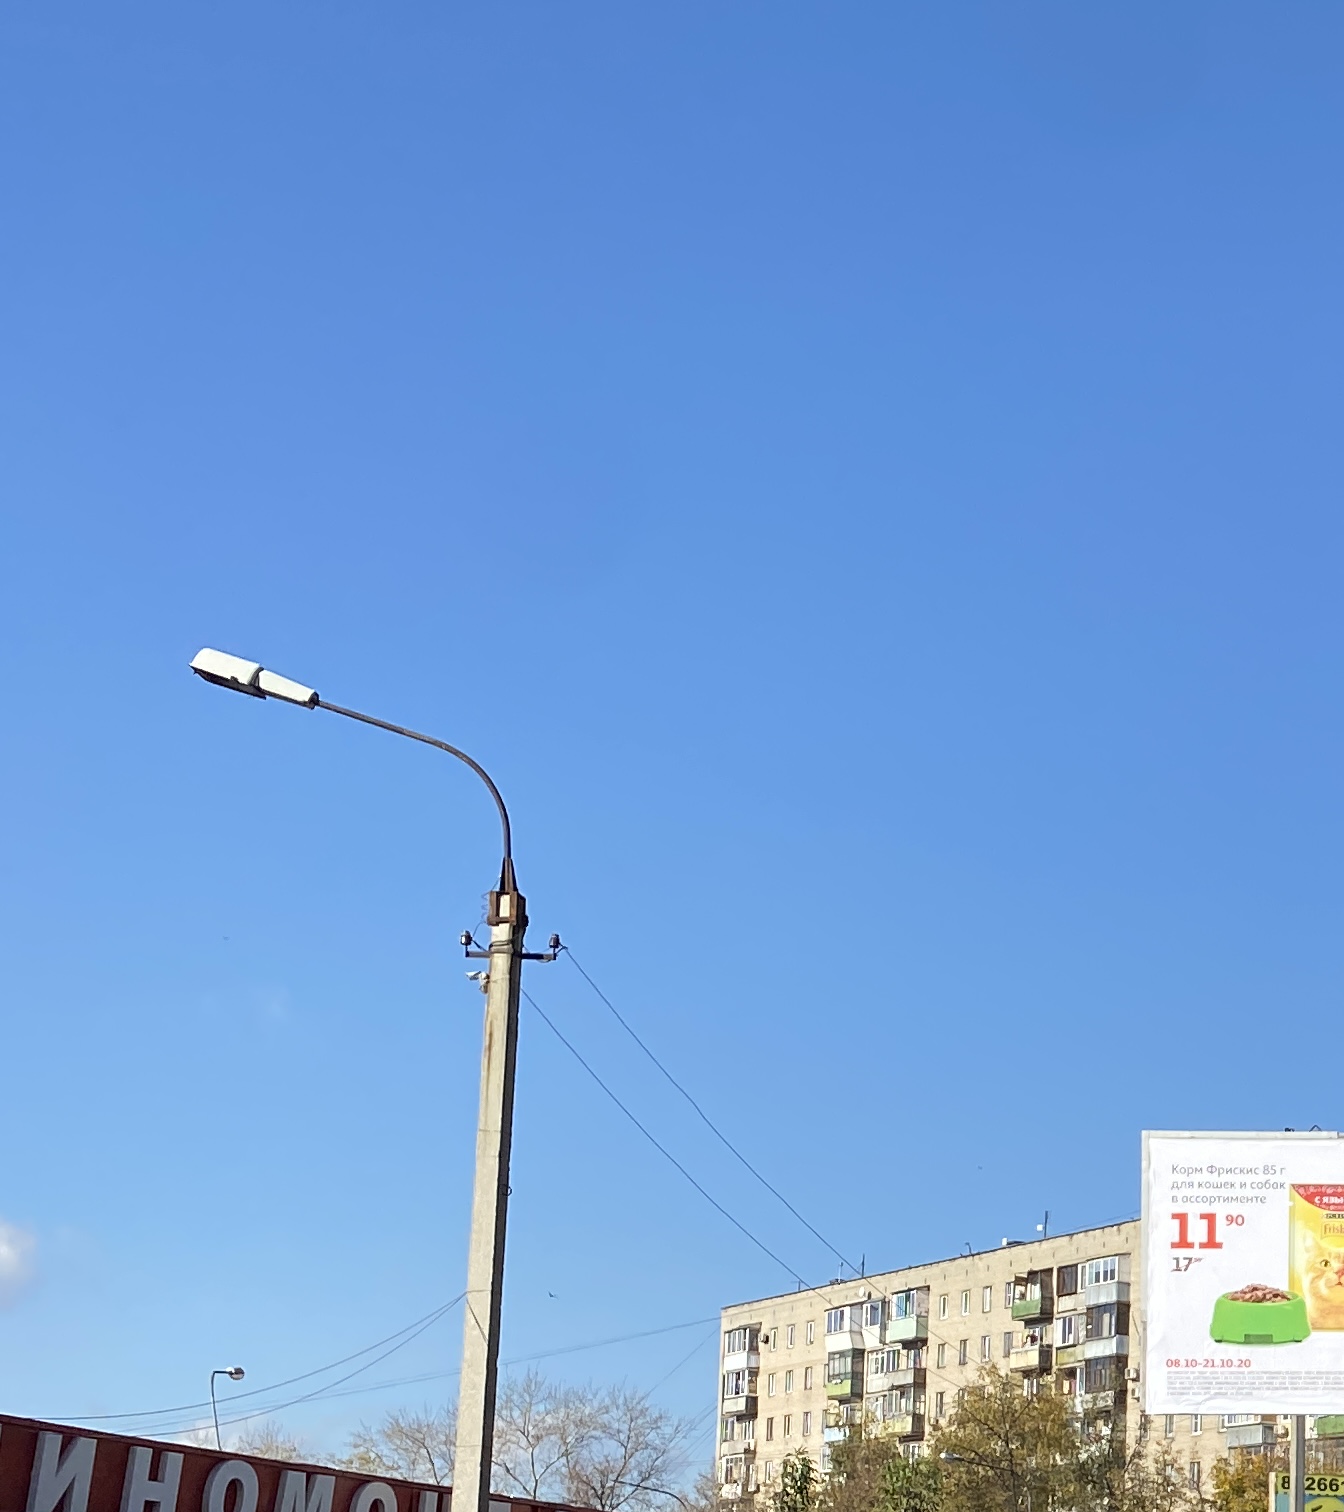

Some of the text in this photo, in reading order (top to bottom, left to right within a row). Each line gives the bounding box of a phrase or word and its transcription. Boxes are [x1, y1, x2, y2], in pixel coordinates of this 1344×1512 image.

[1171, 1164, 1286, 1177] Корм Фрискис 85 г
[1170, 1178, 1286, 1190] для кошек и собак
[1171, 1195, 1267, 1206] в ассортименте
[1170, 1212, 1245, 1249] 11 90
[1166, 1358, 1251, 1368] 08.10-21.10.20
